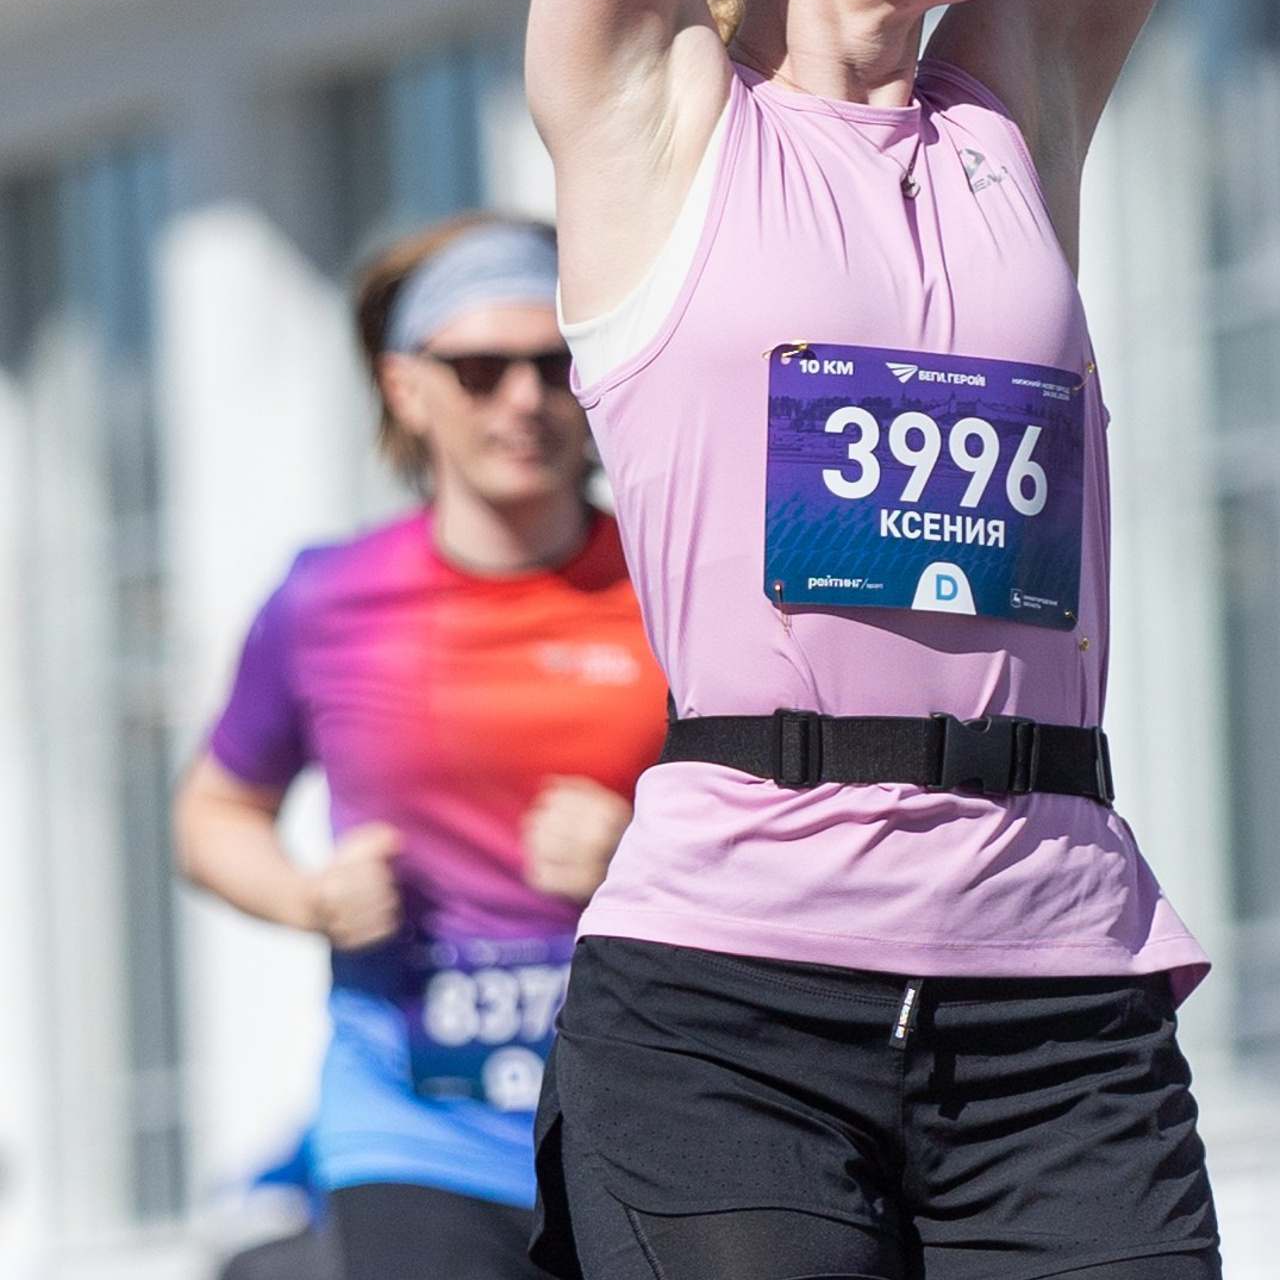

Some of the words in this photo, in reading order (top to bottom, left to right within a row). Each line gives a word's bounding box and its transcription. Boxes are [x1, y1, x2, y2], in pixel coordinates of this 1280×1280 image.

[799, 359, 820, 374] 10
[822, 405, 1048, 517] 3996
[880, 508, 1006, 549] КСЕНИЯ
[935, 574, 959, 602] D
[424, 968, 572, 1046] 837
